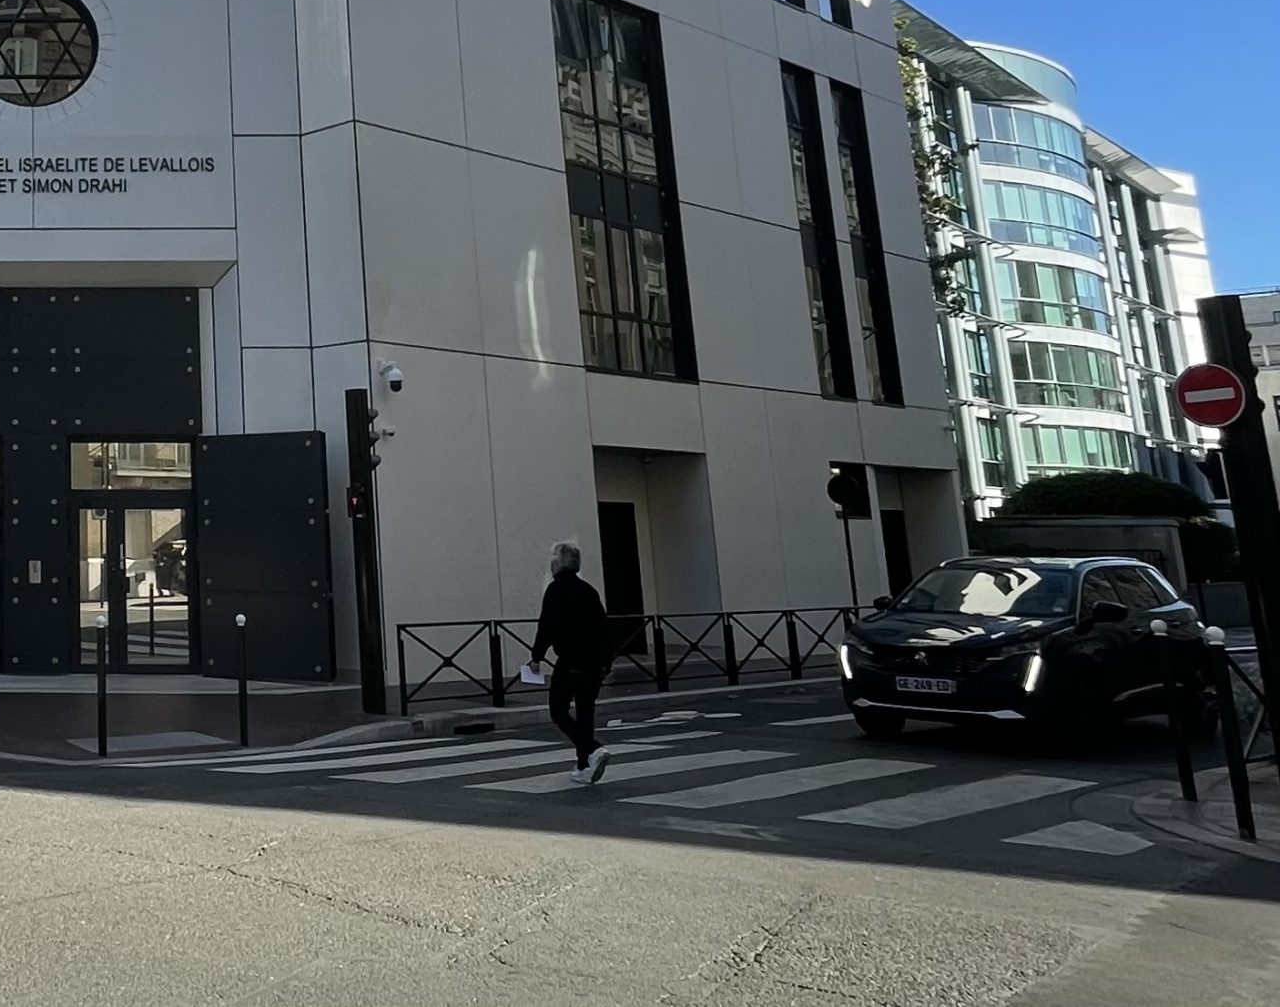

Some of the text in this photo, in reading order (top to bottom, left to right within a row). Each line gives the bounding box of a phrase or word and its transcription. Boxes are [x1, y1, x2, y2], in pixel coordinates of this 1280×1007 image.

[18, 157, 98, 173] ISRAELITE
[103, 157, 125, 173] DE
[129, 157, 215, 173] LEVALLOIS
[22, 178, 73, 194] SIMON
[78, 178, 127, 193] DRAHI
